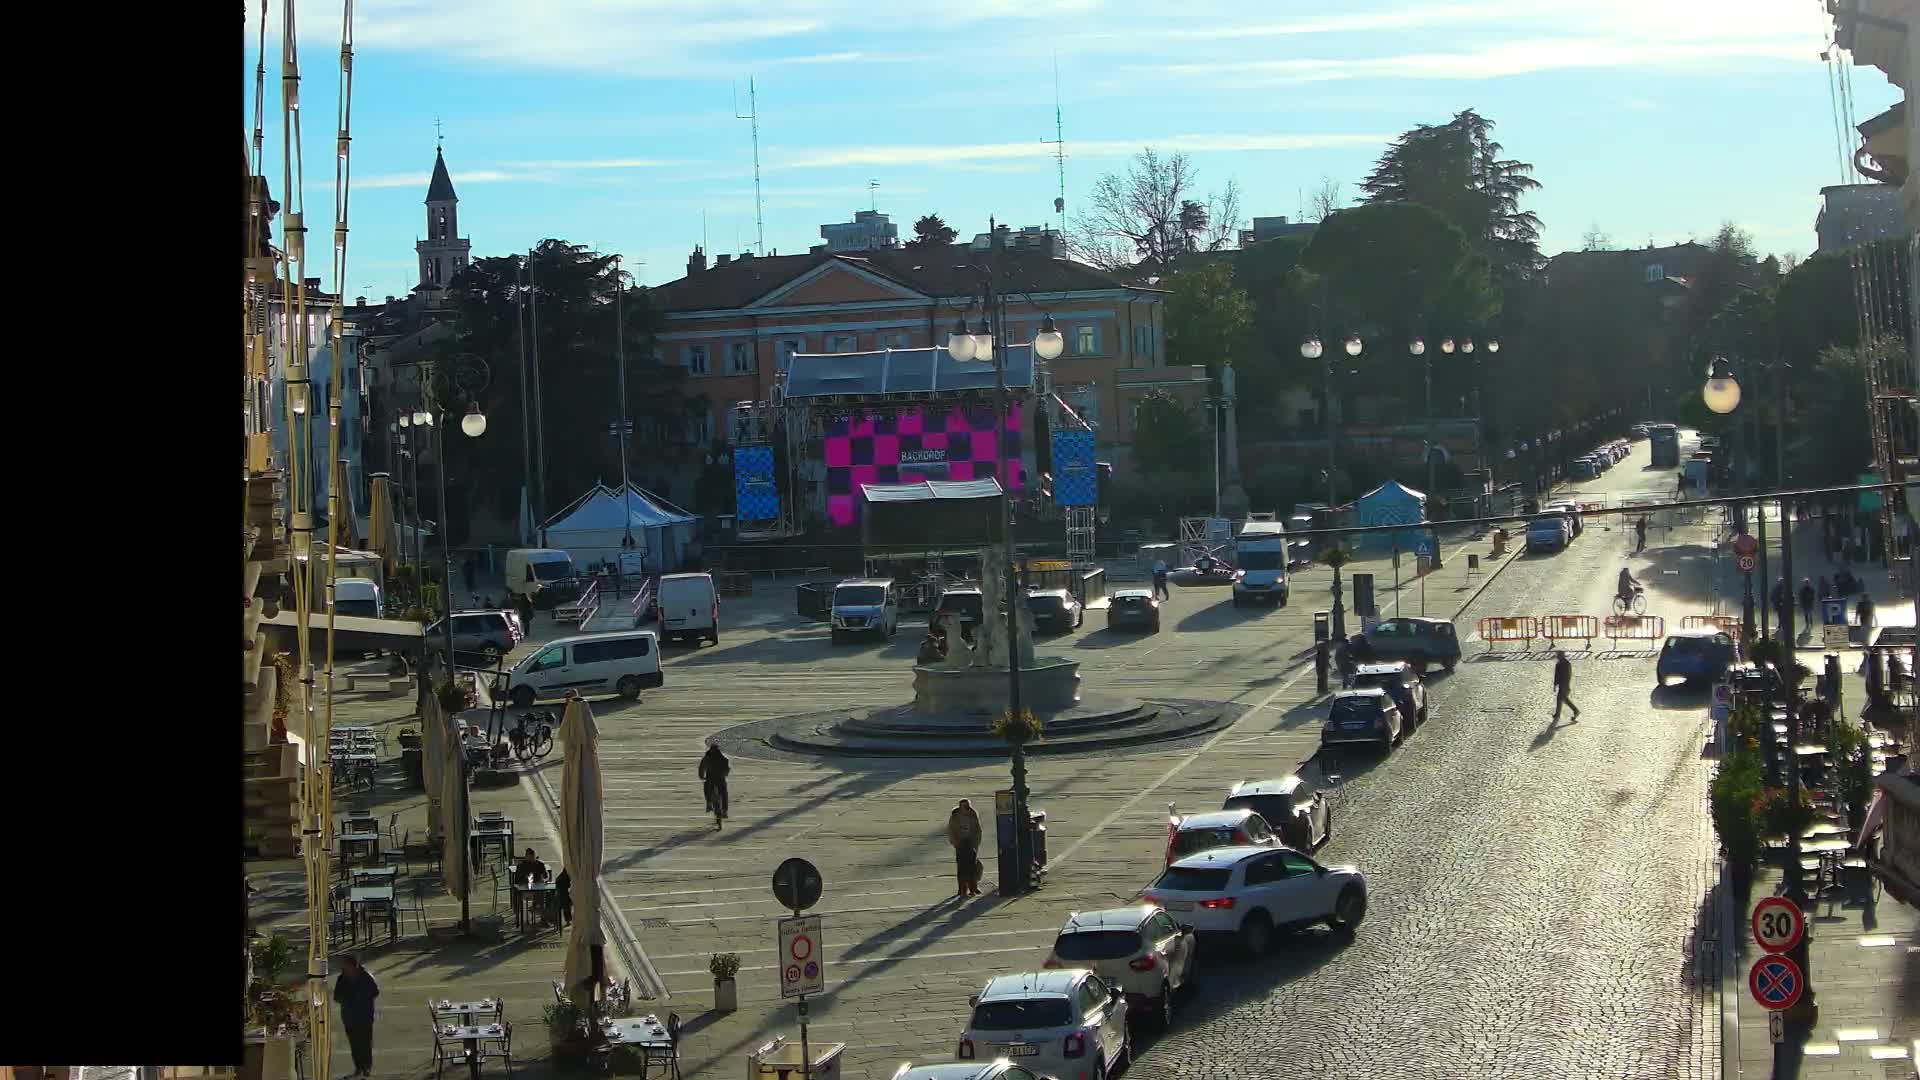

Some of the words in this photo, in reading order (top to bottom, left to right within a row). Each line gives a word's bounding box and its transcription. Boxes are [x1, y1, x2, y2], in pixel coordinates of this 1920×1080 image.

[901, 450, 946, 462] BACKDROP
[1742, 558, 1753, 567] 20
[1828, 603, 1841, 623] P
[1762, 912, 1792, 939] 30
